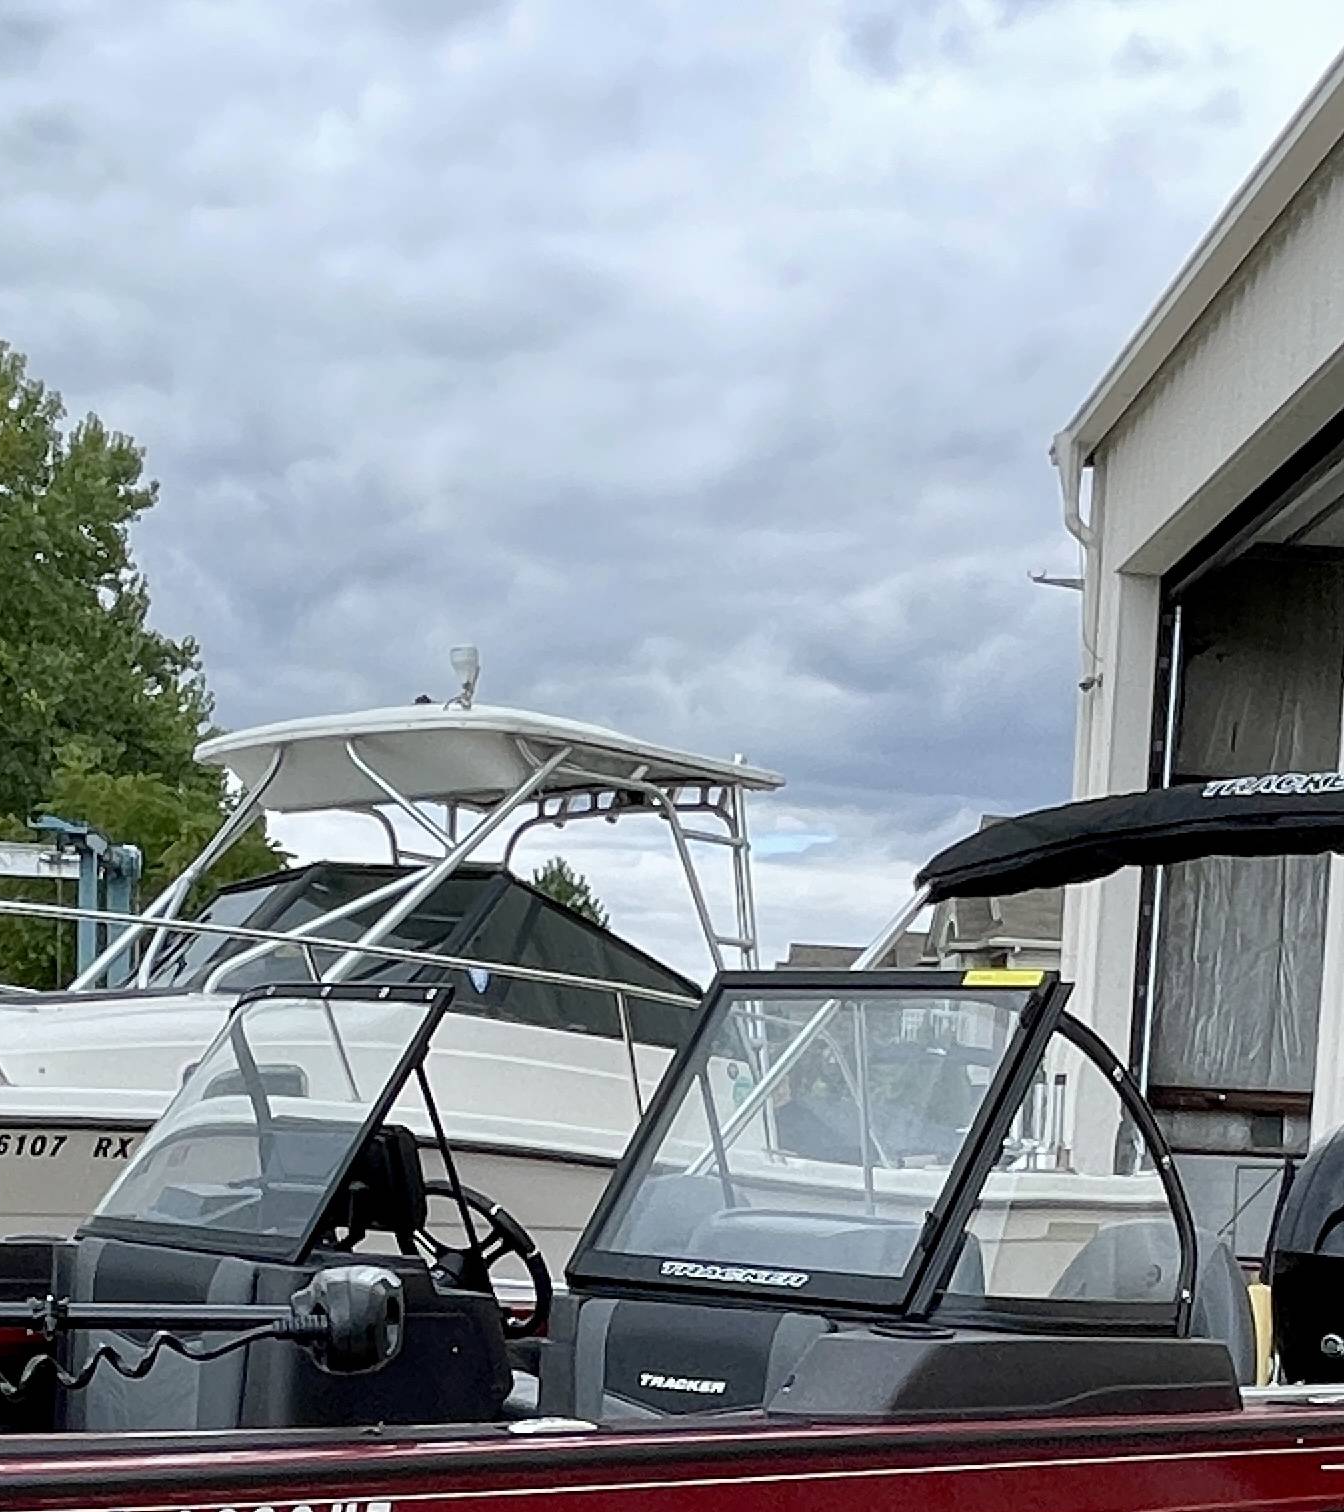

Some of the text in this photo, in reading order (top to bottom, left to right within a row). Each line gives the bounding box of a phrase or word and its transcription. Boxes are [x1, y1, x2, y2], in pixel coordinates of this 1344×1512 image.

[93, 1137, 134, 1159] RX
[660, 1260, 810, 1288] TRACKER
[639, 1372, 726, 1394] TRACKER
